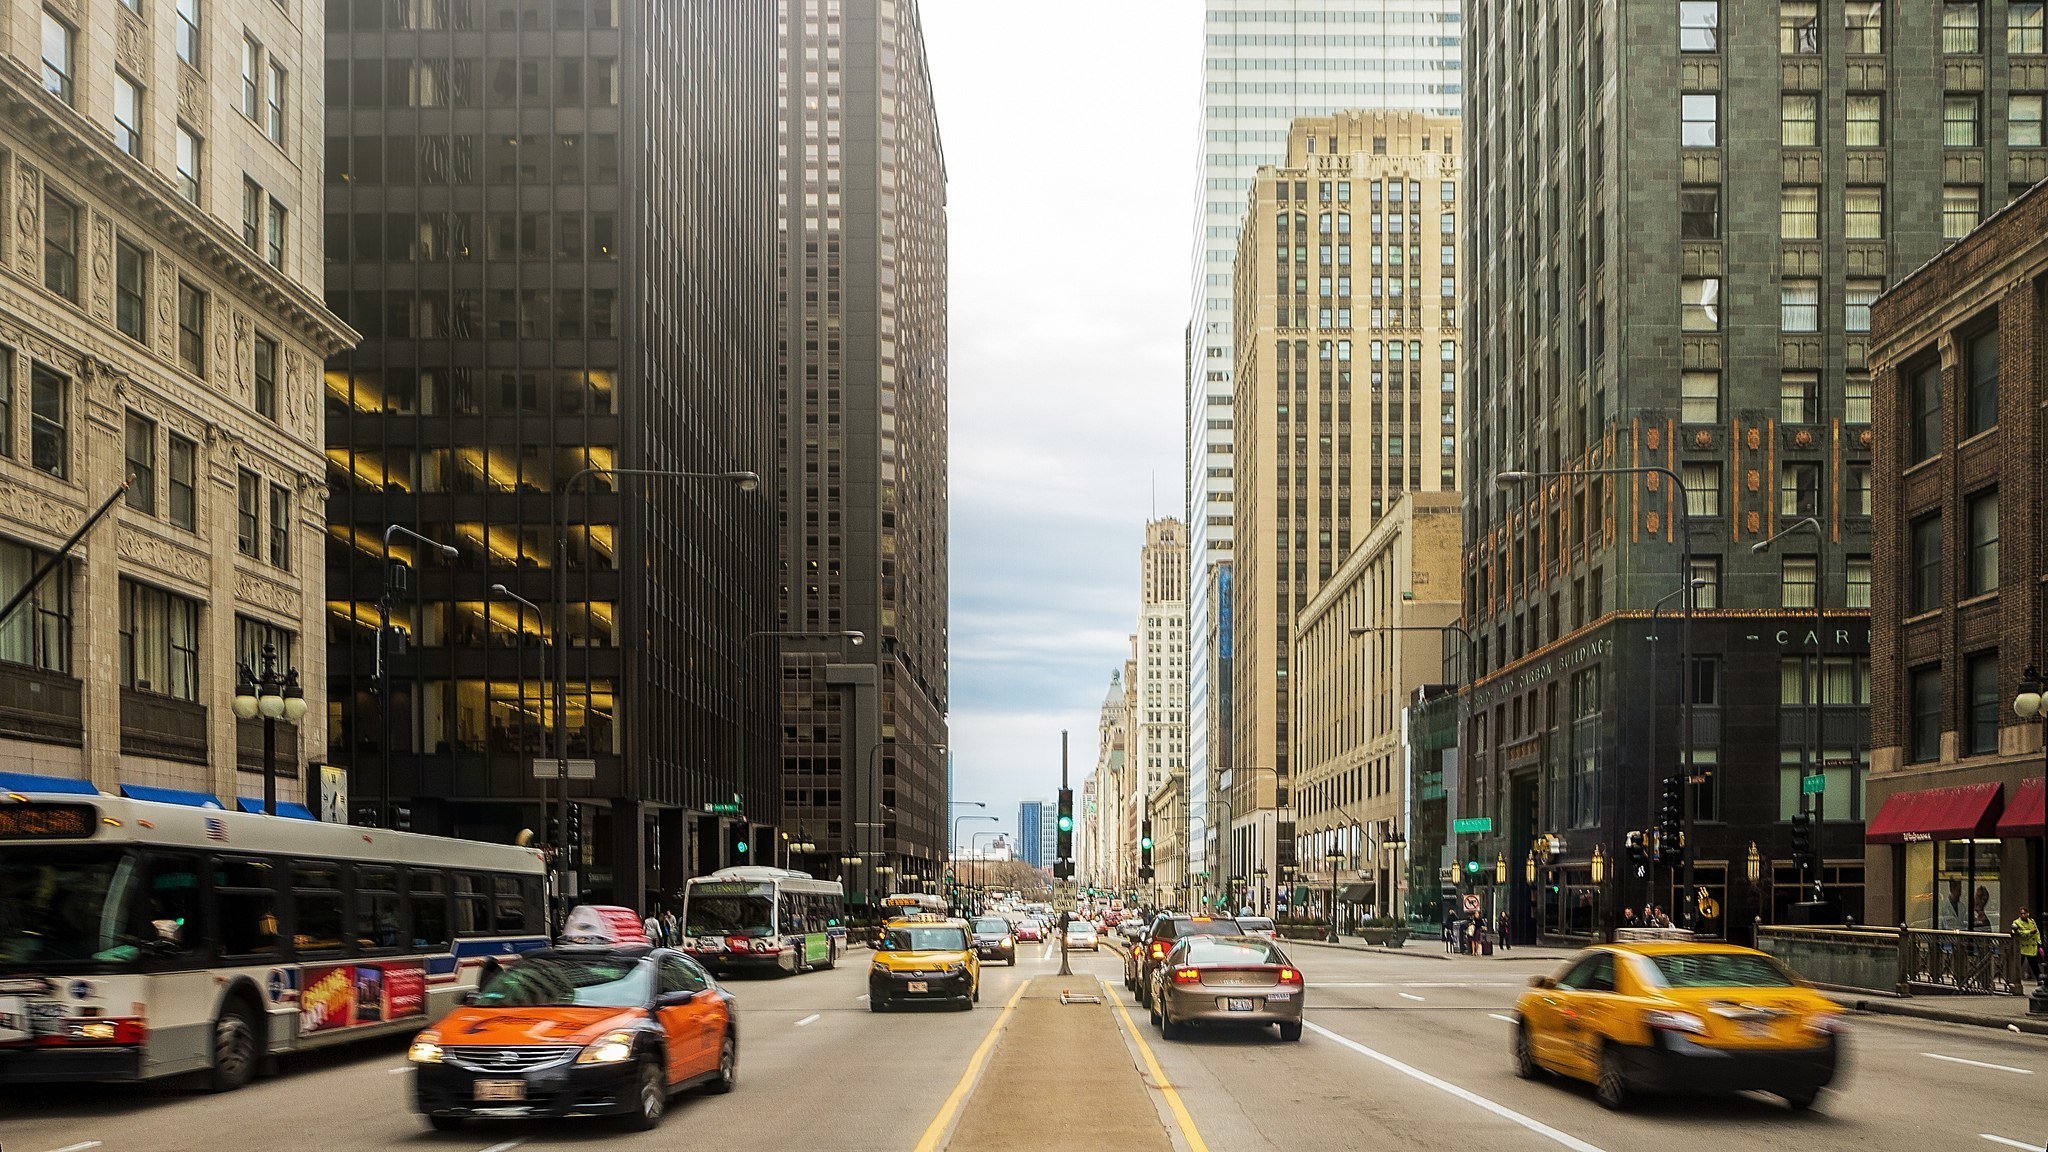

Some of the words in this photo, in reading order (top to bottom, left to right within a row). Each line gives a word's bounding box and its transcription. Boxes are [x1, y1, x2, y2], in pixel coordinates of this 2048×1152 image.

[1776, 629, 1871, 645] CAR
[1519, 662, 1551, 688] CARBON
[1558, 638, 1604, 671] BUILDING
